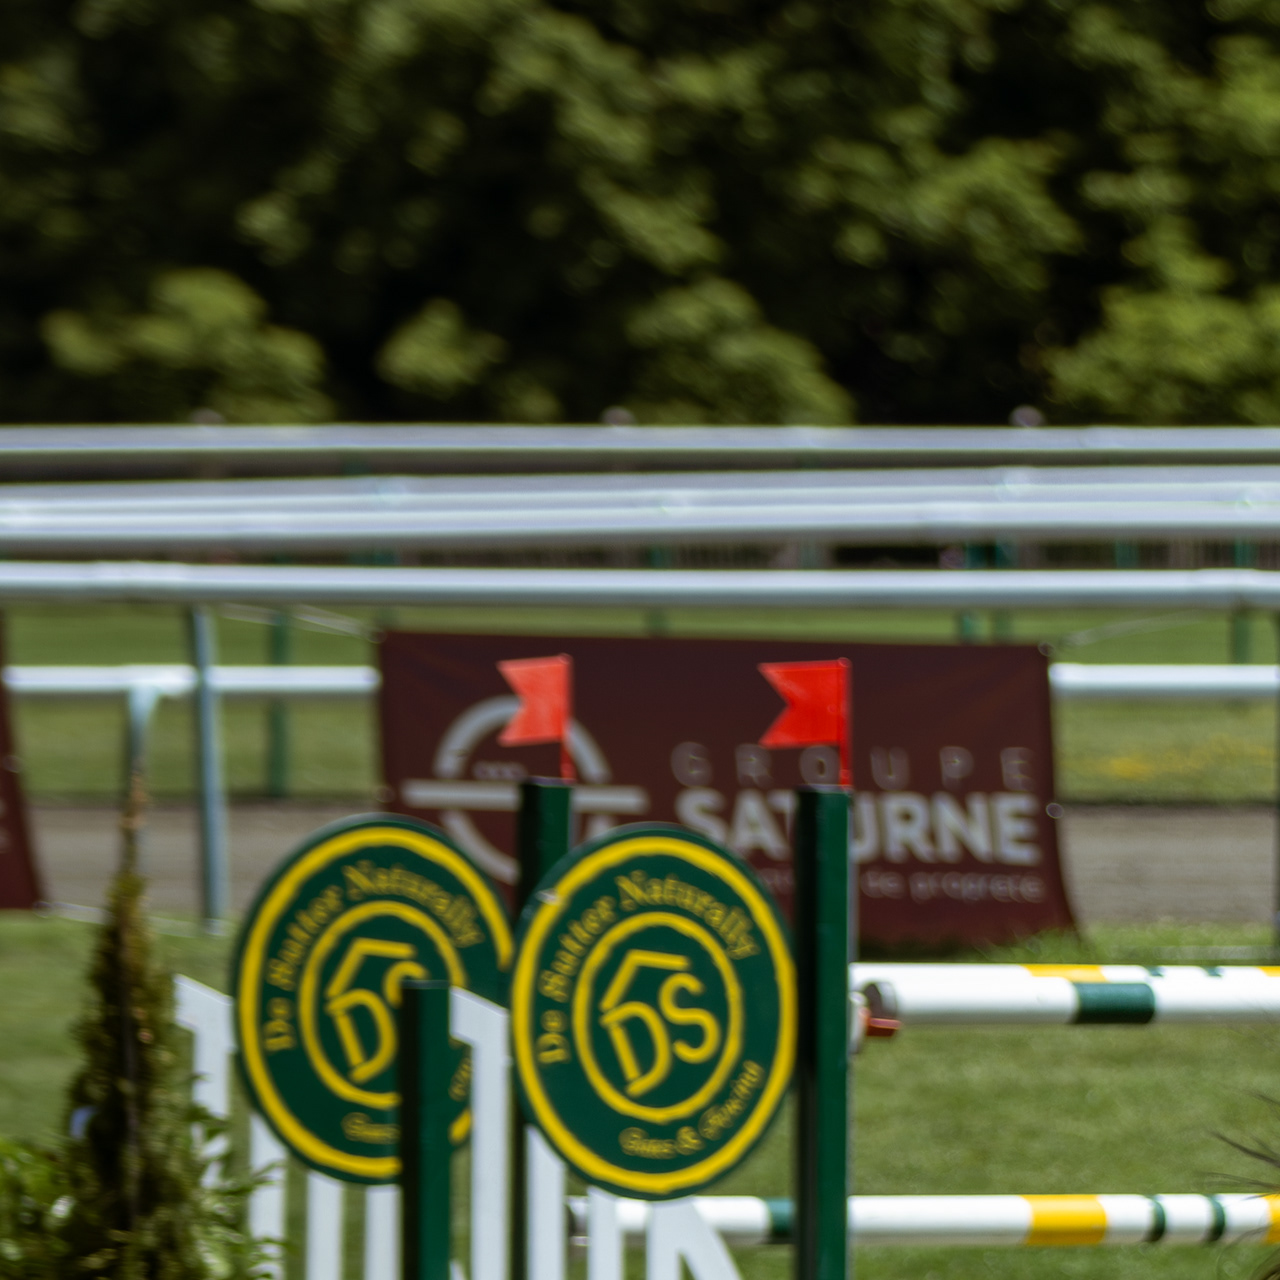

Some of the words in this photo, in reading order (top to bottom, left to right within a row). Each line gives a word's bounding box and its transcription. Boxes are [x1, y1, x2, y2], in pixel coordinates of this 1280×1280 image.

[670, 741, 1035, 792] GROUPE
[537, 896, 617, 1002] Sutter
[615, 869, 760, 959] Naturally
[536, 1010, 571, 1065] De
[600, 972, 721, 1096] DS
